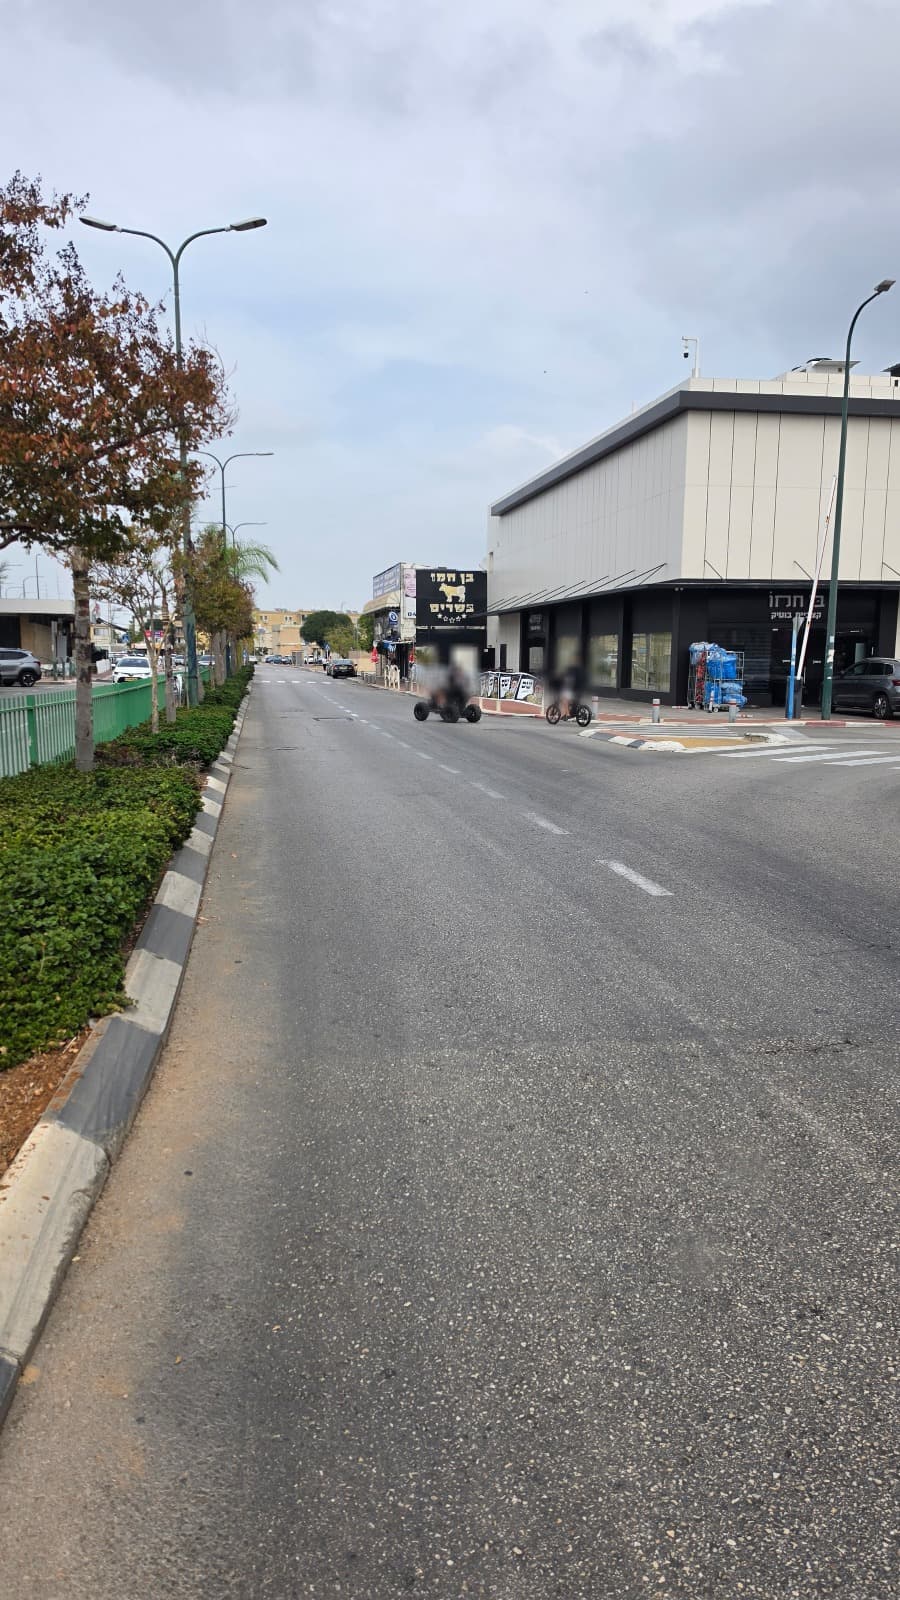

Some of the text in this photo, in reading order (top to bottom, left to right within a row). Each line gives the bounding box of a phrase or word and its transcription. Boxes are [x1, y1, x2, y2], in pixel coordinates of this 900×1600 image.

[430, 573, 474, 584] בן חמו
[429, 603, 474, 613] בשרים
[770, 612, 792, 620] בוטיק
